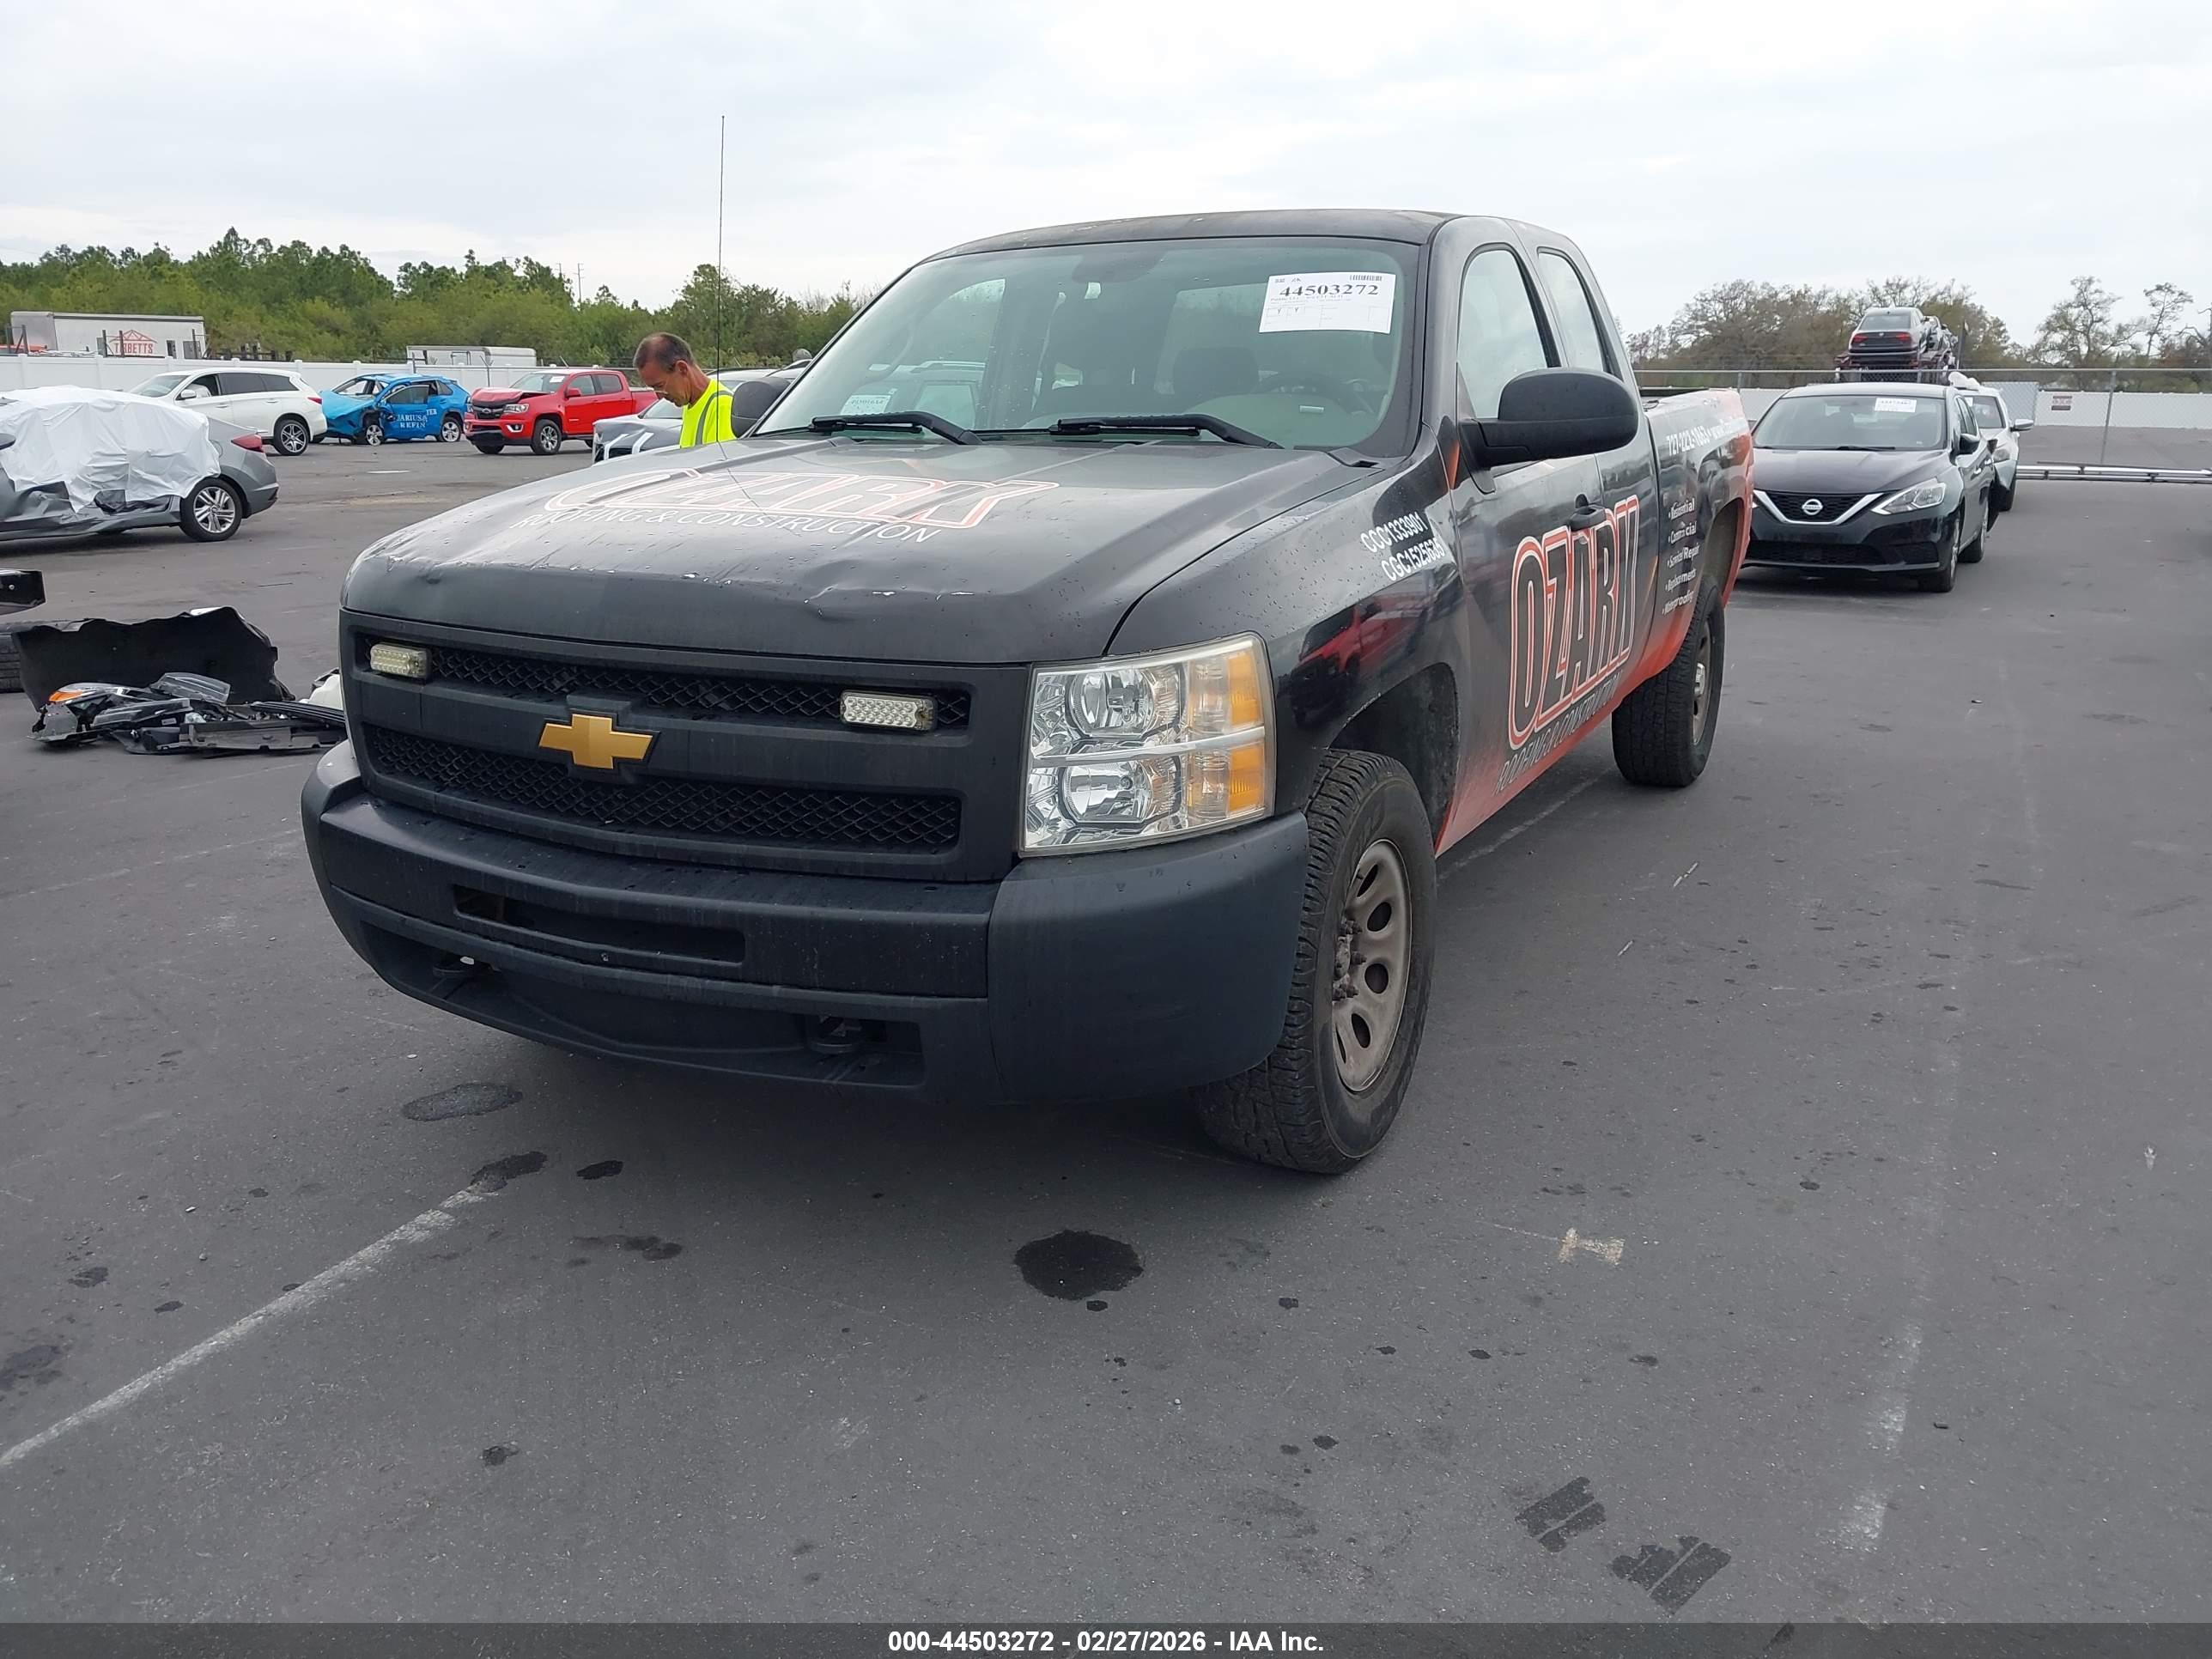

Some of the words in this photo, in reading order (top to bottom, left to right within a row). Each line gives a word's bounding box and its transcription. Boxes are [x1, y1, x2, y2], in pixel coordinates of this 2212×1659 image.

[1279, 284, 1379, 296] 44503272
[113, 343, 154, 355] TBBETTS
[509, 508, 653, 529] ROOFING
[646, 510, 679, 524] &
[678, 511, 942, 543] CONSTRUCTION
[1360, 511, 1429, 553] CCC1333901
[1381, 537, 1446, 581] CGC1525635
[1509, 495, 1639, 750] OZARK
